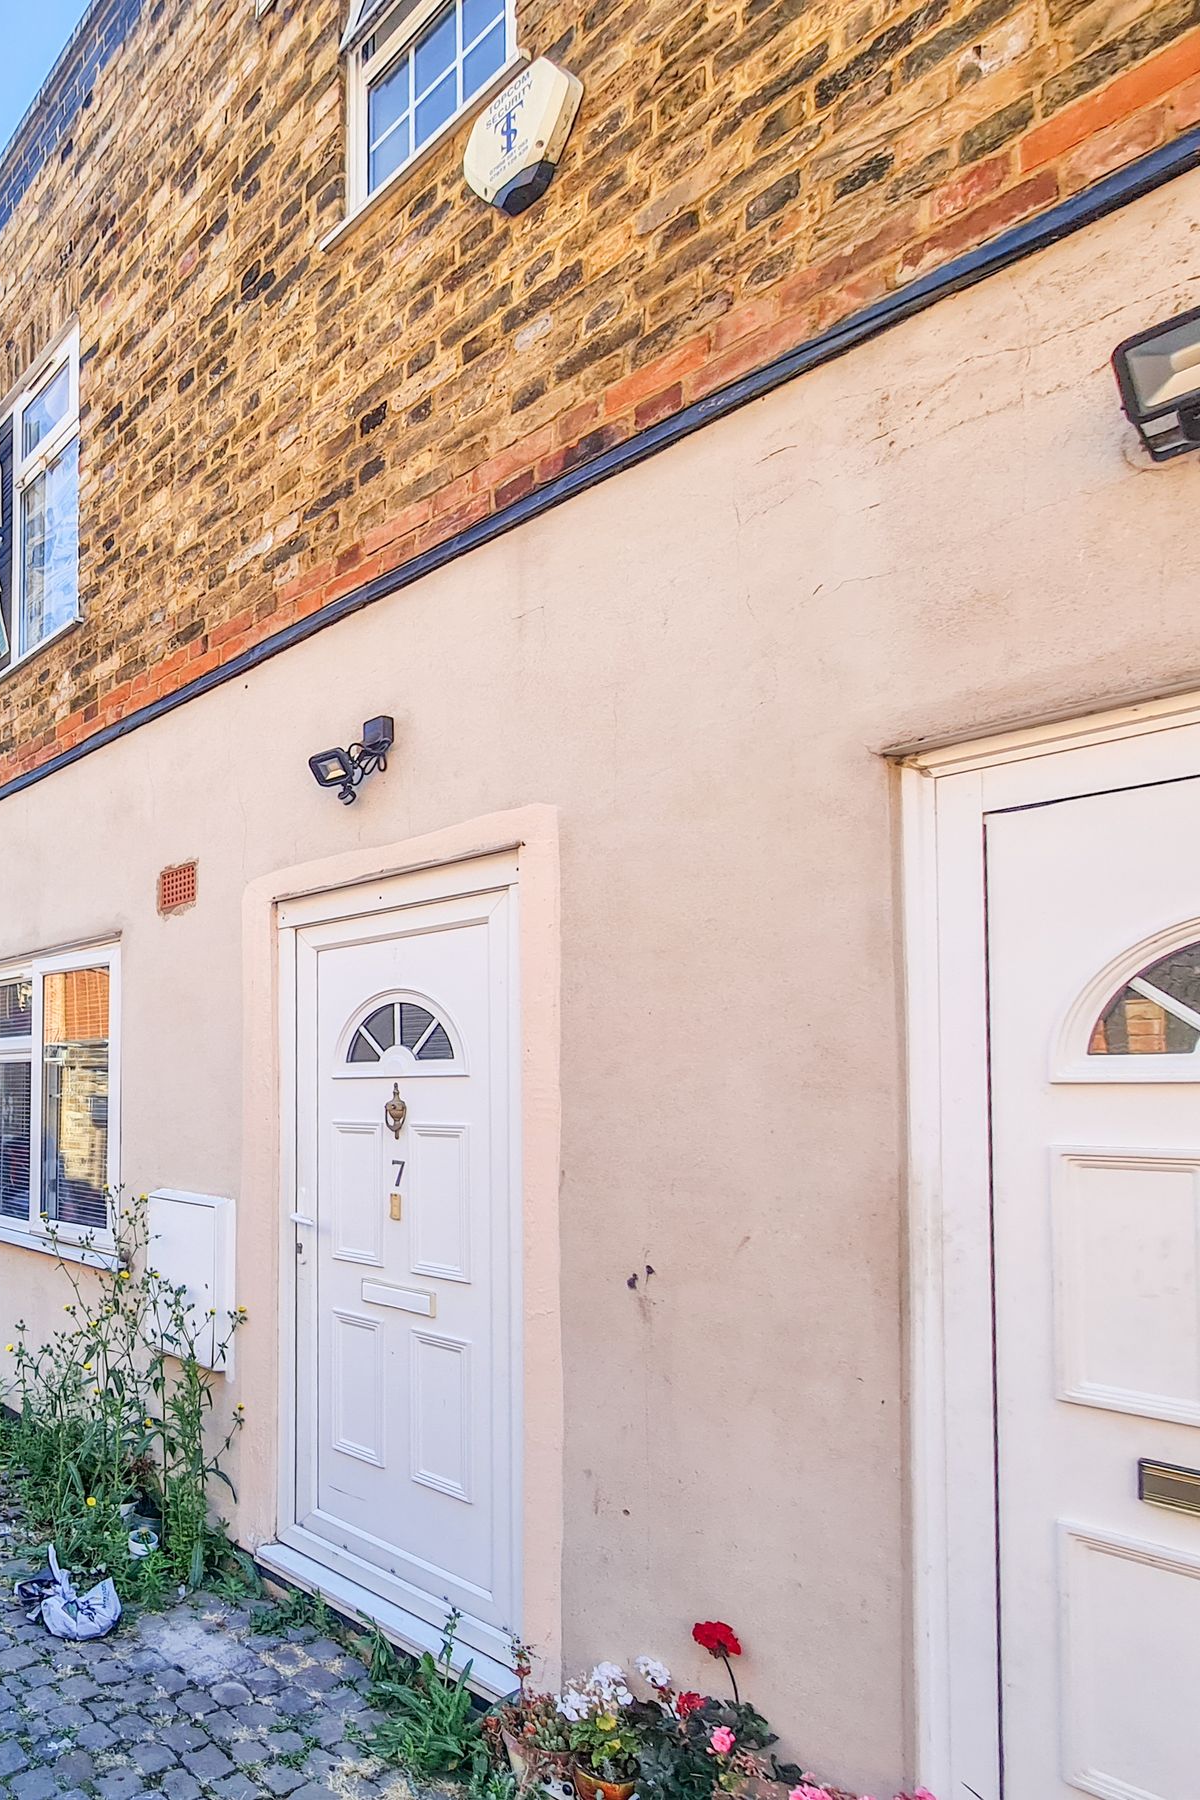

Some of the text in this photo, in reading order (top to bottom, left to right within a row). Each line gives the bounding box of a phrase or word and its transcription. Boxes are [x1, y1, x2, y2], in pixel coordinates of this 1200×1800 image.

[485, 80, 533, 130] SECURITY
[489, 71, 530, 114] TOPCOM
[391, 1160, 405, 1187] 7
